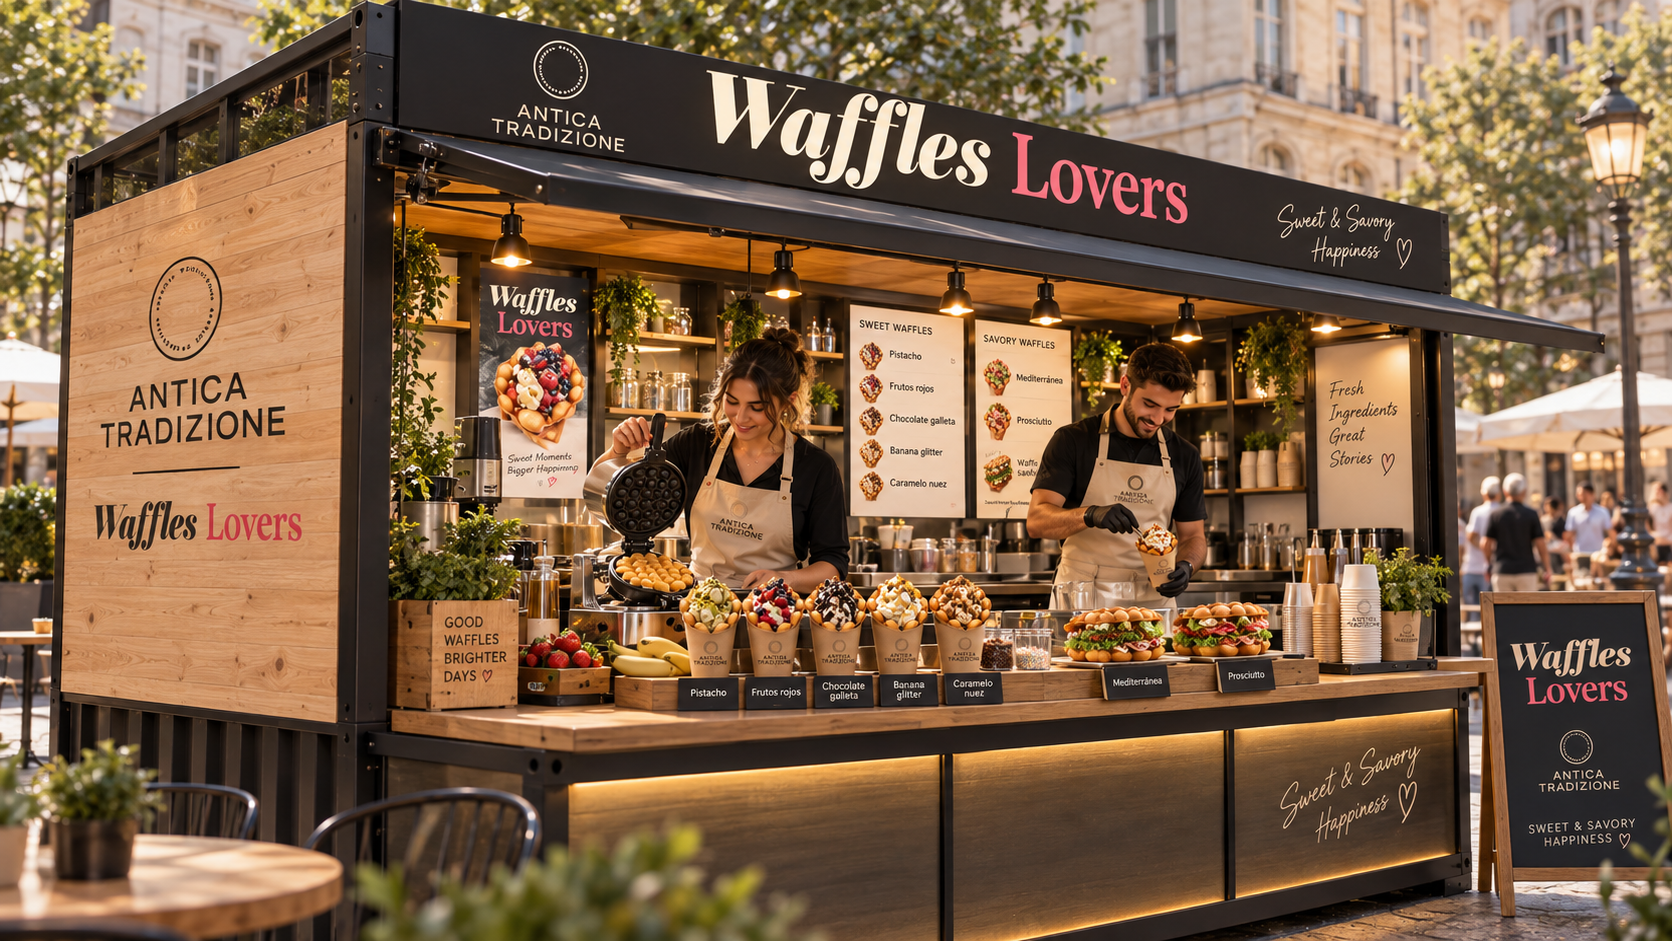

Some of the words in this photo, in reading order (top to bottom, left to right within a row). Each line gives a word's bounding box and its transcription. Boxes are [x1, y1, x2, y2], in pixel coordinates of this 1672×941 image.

[517, 104, 601, 130] ANTICA
[491, 118, 625, 153] TRADIZIONE
[706, 70, 991, 190] Waffles
[1011, 132, 1189, 225] Lovers
[1277, 203, 1326, 239] Sweet
[1330, 206, 1341, 229] &
[1345, 203, 1395, 242] Savory
[1311, 235, 1381, 267] Happiness
[489, 284, 577, 316] Waffles
[497, 311, 573, 339] Lovers
[859, 319, 890, 331] SWEET
[893, 323, 933, 335] WAFFLES
[983, 334, 1016, 345] SAVORY
[1019, 338, 1055, 349] WAFFLES
[889, 350, 922, 360] Pistacho
[129, 372, 247, 412] ANTICA
[889, 382, 914, 391] Frutos
[916, 384, 935, 394] rojos
[1329, 380, 1364, 399] Fresh
[1328, 401, 1398, 425] Ingredients
[889, 414, 929, 424] Chocolate
[930, 416, 956, 426] galleta
[101, 406, 285, 448] TRADIZIONE
[1329, 427, 1365, 446] Great
[535, 452, 572, 462] Moments
[890, 446, 919, 455] Banana
[920, 448, 943, 458] glitter
[1329, 450, 1373, 468] Stories
[507, 465, 534, 477] Bigger
[890, 478, 927, 487] Caramelo
[929, 480, 947, 488] nuez
[94, 501, 197, 551] Waffles
[206, 503, 302, 542] Lovers
[719, 518, 754, 530] ANTICA
[711, 522, 763, 541] TRADIZIONE
[444, 616, 483, 628] GOOD
[444, 633, 499, 646] WAFFLES
[444, 651, 507, 664] BRIGHTER
[1510, 638, 1632, 677] Waffles
[444, 670, 477, 683] DAYS
[1112, 676, 1163, 687] Mediterránea
[1228, 670, 1265, 680] Prosciutto
[822, 681, 866, 691] Chocolate
[893, 680, 925, 689] Banana
[953, 679, 993, 688] Caramelo
[690, 688, 727, 697] Pistacho
[751, 688, 778, 697] Frutos
[780, 688, 801, 698] rojos
[896, 691, 922, 701] glitter
[964, 689, 985, 698] nuez
[1525, 677, 1629, 705] Lovers
[1552, 770, 1605, 780] ANTICA
[1280, 767, 1337, 830] Sweet
[1340, 761, 1354, 788] &
[1359, 746, 1421, 786] Savory
[1538, 780, 1620, 793] TRADIZIONE
[1315, 794, 1389, 844] Happiness
[1528, 822, 1569, 834] SWEET
[1574, 821, 1582, 831] &
[1587, 818, 1636, 831] SAVORY
[1544, 833, 1612, 847] HAPPINESS
